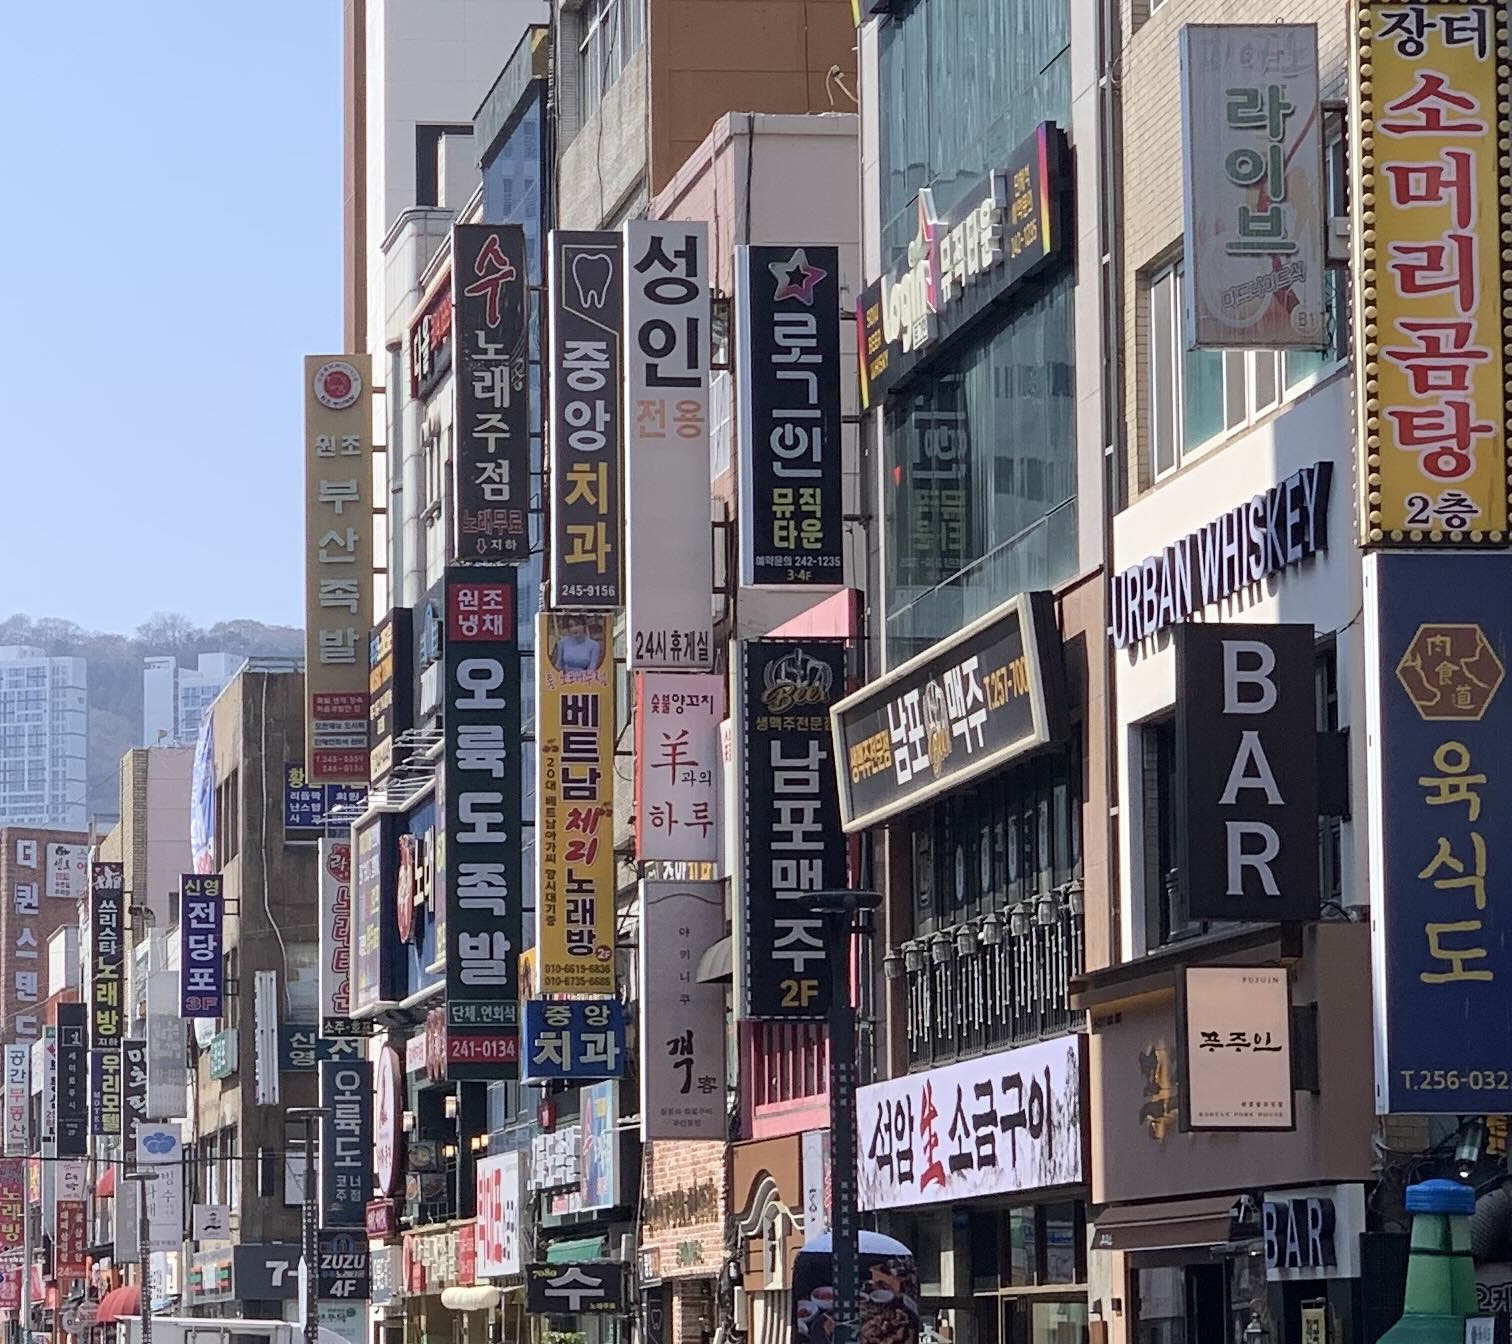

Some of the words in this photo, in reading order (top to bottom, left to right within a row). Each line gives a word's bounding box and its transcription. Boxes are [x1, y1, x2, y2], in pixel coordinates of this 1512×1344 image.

[1377, 7, 1487, 60] 장터
[1224, 81, 1299, 256] 라이브
[1378, 72, 1494, 479] 소머리곰탕
[633, 234, 703, 389] 성인
[471, 330, 513, 502] 노래주점
[636, 398, 705, 440] 전용
[770, 311, 824, 479] 로그인
[314, 433, 362, 457] 원조
[1405, 493, 1481, 530] 2층
[317, 478, 360, 666] 부산족발
[490, 538, 517, 552] 지하
[794, 555, 841, 568] 242-1235
[1110, 538, 1192, 649] URBAN
[1193, 461, 1324, 607] WHISKEY
[456, 588, 504, 611] 원조
[561, 584, 616, 598] 245-9156
[457, 613, 504, 637] 냉채
[650, 692, 714, 715] 숯불양꼬치
[560, 693, 602, 802] 베트남
[650, 728, 699, 787] 羊
[1218, 638, 1285, 897] BAR
[454, 657, 511, 986] 오륙도족발
[564, 806, 600, 866] 체리
[648, 800, 714, 839] 하루
[769, 739, 828, 975] 남포맥주
[1418, 738, 1495, 985] 육식도
[184, 879, 220, 896] 신영
[564, 867, 596, 957] 노래방
[97, 898, 118, 956] 쓰리스타
[186, 901, 219, 992] 전당포
[96, 955, 119, 1036] 노래방
[543, 1004, 611, 1028] 중앙
[779, 979, 820, 1009] 2F
[450, 1040, 516, 1058] 241-0134
[533, 1029, 621, 1073] 치과
[101, 1054, 121, 1133] 우리모텔
[333, 1069, 363, 1168] 오륙도
[320, 1254, 367, 1270] ZUZU
[1262, 1197, 1326, 1270] BAR
[329, 1279, 357, 1298] 4F
[544, 1266, 606, 1312] 수
